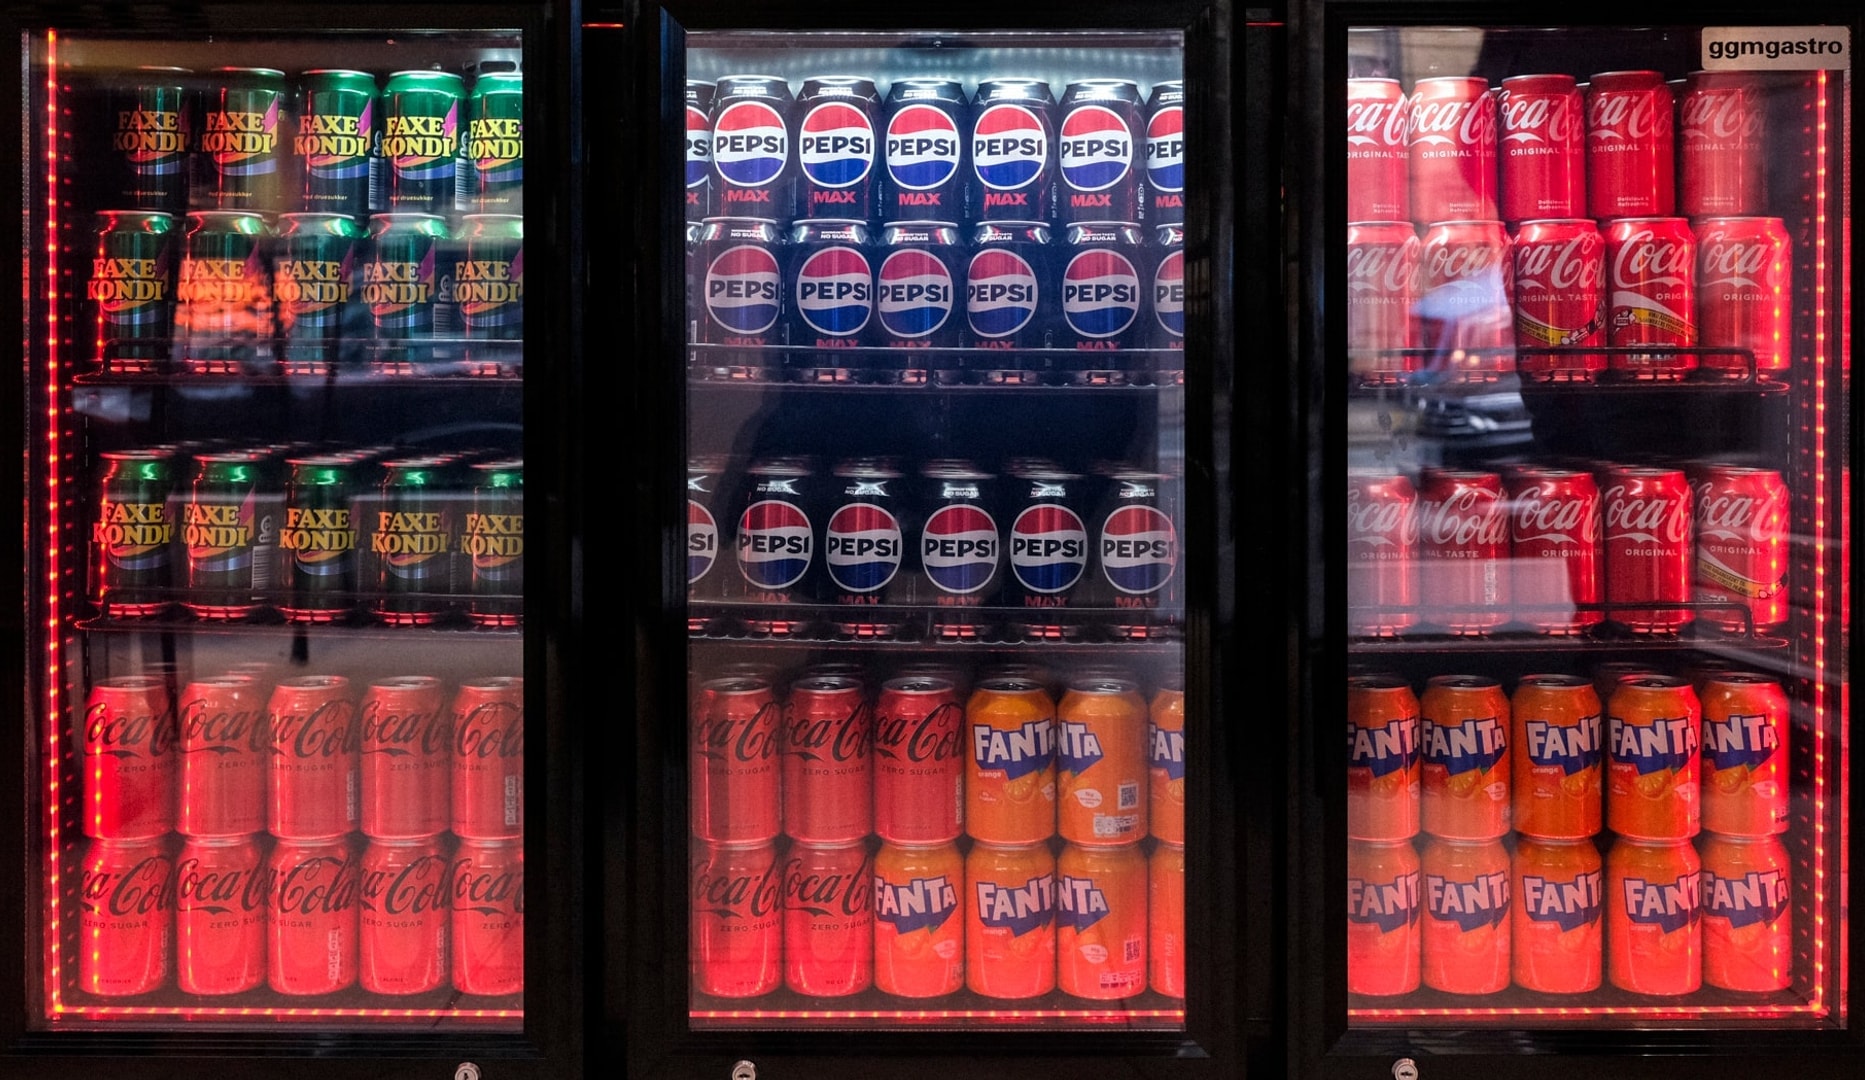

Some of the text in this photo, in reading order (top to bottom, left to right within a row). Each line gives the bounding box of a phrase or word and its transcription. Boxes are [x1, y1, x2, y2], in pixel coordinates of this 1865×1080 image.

[1708, 38, 1843, 59] ggmgastro
[118, 111, 178, 131] FAXE
[206, 112, 264, 132] FAXE
[300, 115, 359, 134] FAXE
[386, 117, 444, 137] FAXE
[470, 119, 521, 139] FAXE
[114, 132, 185, 153] KONDI
[294, 136, 366, 157] KONDI
[716, 135, 785, 153] PEPSI
[803, 136, 871, 154] PEPSI
[888, 138, 956, 156] PEPSI
[975, 138, 1043, 157] PEPSI
[1061, 140, 1128, 159] PEPSI
[1148, 141, 1183, 160] PEP
[1510, 147, 1560, 156] ORIGINAL
[1592, 144, 1640, 153] ORIGINAL
[1422, 150, 1471, 159] ORIGINAL
[727, 190, 770, 202] MAX
[814, 191, 856, 203] MAX
[899, 193, 941, 205] MAX
[984, 193, 1027, 205] MAX
[1070, 194, 1112, 207] MAX
[1156, 195, 1183, 208] MA
[93, 258, 156, 279] FAXE
[181, 260, 246, 281] FAXE
[279, 261, 341, 282] FAXE
[363, 261, 420, 282] FAXE
[455, 260, 511, 281] FAXE
[87, 280, 164, 301] KONDI
[177, 281, 253, 302] KONDI
[273, 282, 348, 303] KONDI
[709, 279, 779, 301] PEPSI
[801, 281, 871, 301] PEPSI
[880, 284, 949, 303] PEPSI
[968, 283, 1033, 303] PEPSI
[1065, 284, 1136, 303] PEPSI
[101, 503, 164, 523] FAXE
[184, 504, 239, 526] FAXE
[287, 508, 350, 529] FAXE
[378, 511, 441, 532] FAXE
[465, 513, 523, 534] FAXE
[93, 523, 170, 545] KONDI
[280, 529, 355, 550] KONDI
[371, 533, 448, 553] KONDI
[739, 533, 810, 553] PEPSI
[461, 535, 523, 556] KOND
[828, 536, 899, 557] PEPSI
[924, 538, 996, 558] PEPSI
[1013, 538, 1084, 558] PEPSI
[1104, 539, 1173, 559] PEPSI
[1361, 551, 1411, 560] ORIGINAL
[1446, 550, 1480, 558] TASTE
[1542, 549, 1592, 558] ORIGINAL
[1626, 548, 1677, 557] ORIGINAL
[1710, 545, 1763, 555] ORIGINAL
[1024, 595, 1068, 608] MAX
[1057, 722, 1101, 759] NTA
[1150, 725, 1184, 762] FAN
[1422, 718, 1506, 758] FANTA
[1526, 717, 1601, 759] FANT
[1610, 718, 1697, 758] FANTA
[1703, 715, 1779, 753] ANTA
[116, 765, 146, 774] ZERO
[217, 761, 246, 769] ZERO
[297, 763, 334, 772] SUGAR
[390, 763, 419, 771] ZERO
[803, 767, 830, 776] ZERO
[881, 766, 945, 776] ZERO SUGAR
[978, 771, 1002, 779] orange
[875, 875, 957, 917] FANTA
[1058, 876, 1107, 915] NTA
[1348, 872, 1420, 917] FANT
[1427, 873, 1510, 915] FANTA
[1524, 873, 1601, 916] FANT
[1624, 871, 1700, 917] FANT
[1702, 871, 1789, 911] FANTA
[110, 920, 148, 930] SUGAR
[210, 920, 239, 929] ZERO
[280, 920, 313, 929] SUGAR
[386, 920, 424, 929] SUGAR
[482, 921, 511, 930] ZERO
[720, 923, 748, 933] ZERO
[810, 922, 839, 931] ZERO
